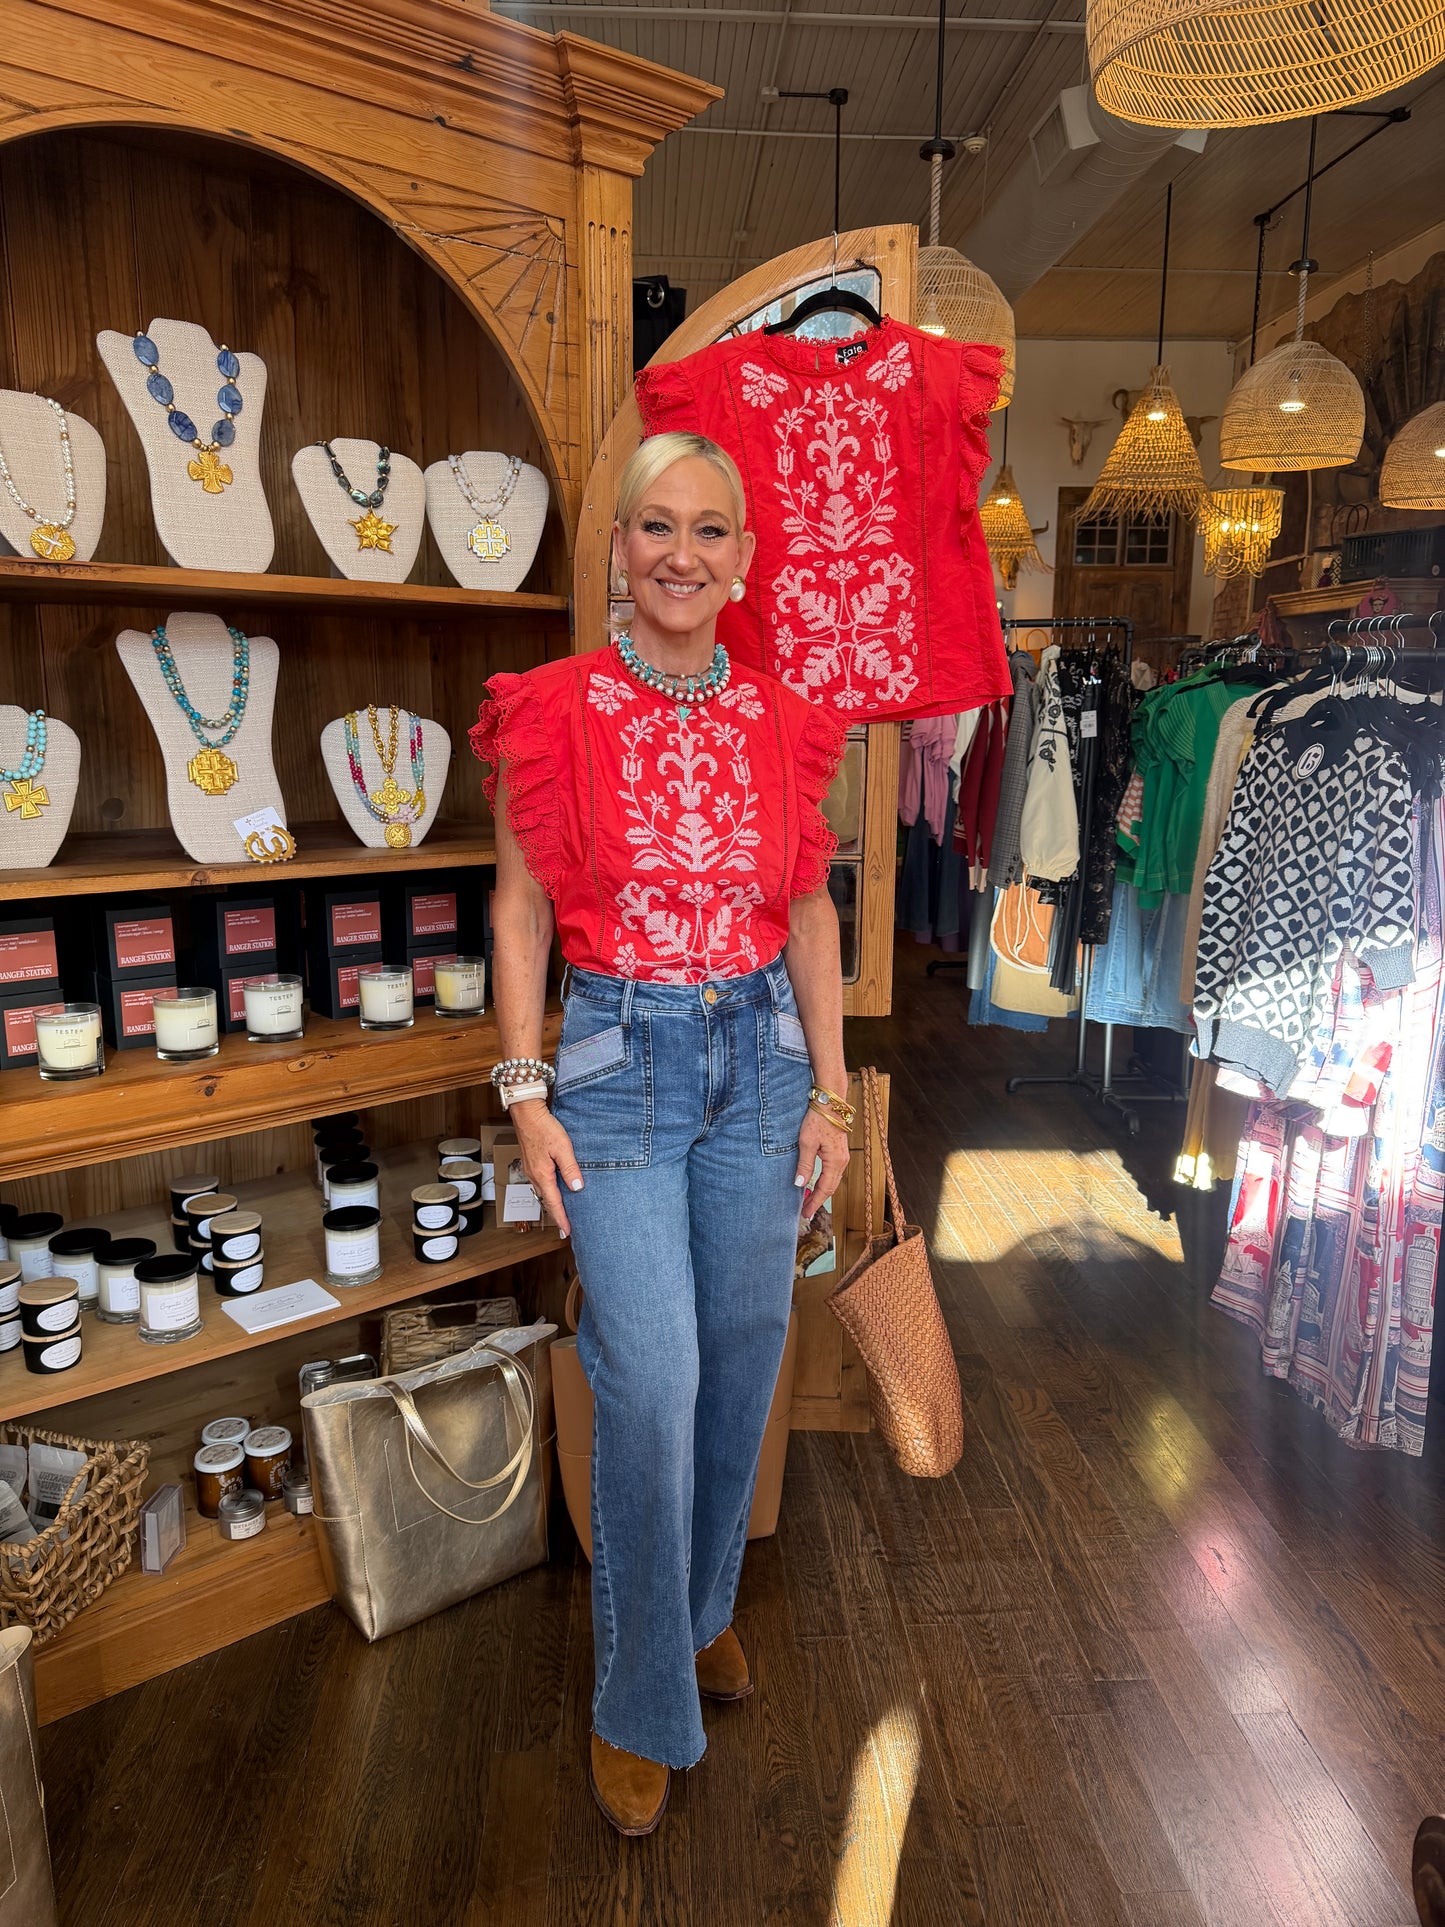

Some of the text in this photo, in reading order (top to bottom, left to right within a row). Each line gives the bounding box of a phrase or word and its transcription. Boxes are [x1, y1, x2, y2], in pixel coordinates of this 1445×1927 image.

[843, 345, 863, 358] Fate
[416, 924, 436, 933] RANGER
[436, 922, 455, 931] STATION
[336, 935, 358, 944] RANGER
[358, 932, 379, 941] STATION
[229, 943, 252, 952] RANGER
[252, 940, 274, 949] STATION
[120, 954, 147, 964] RANGER
[146, 951, 171, 962] STATION
[25, 966, 52, 978] STATION
[268, 993, 293, 1001] TESTER
[126, 1023, 152, 1033] RANGER
